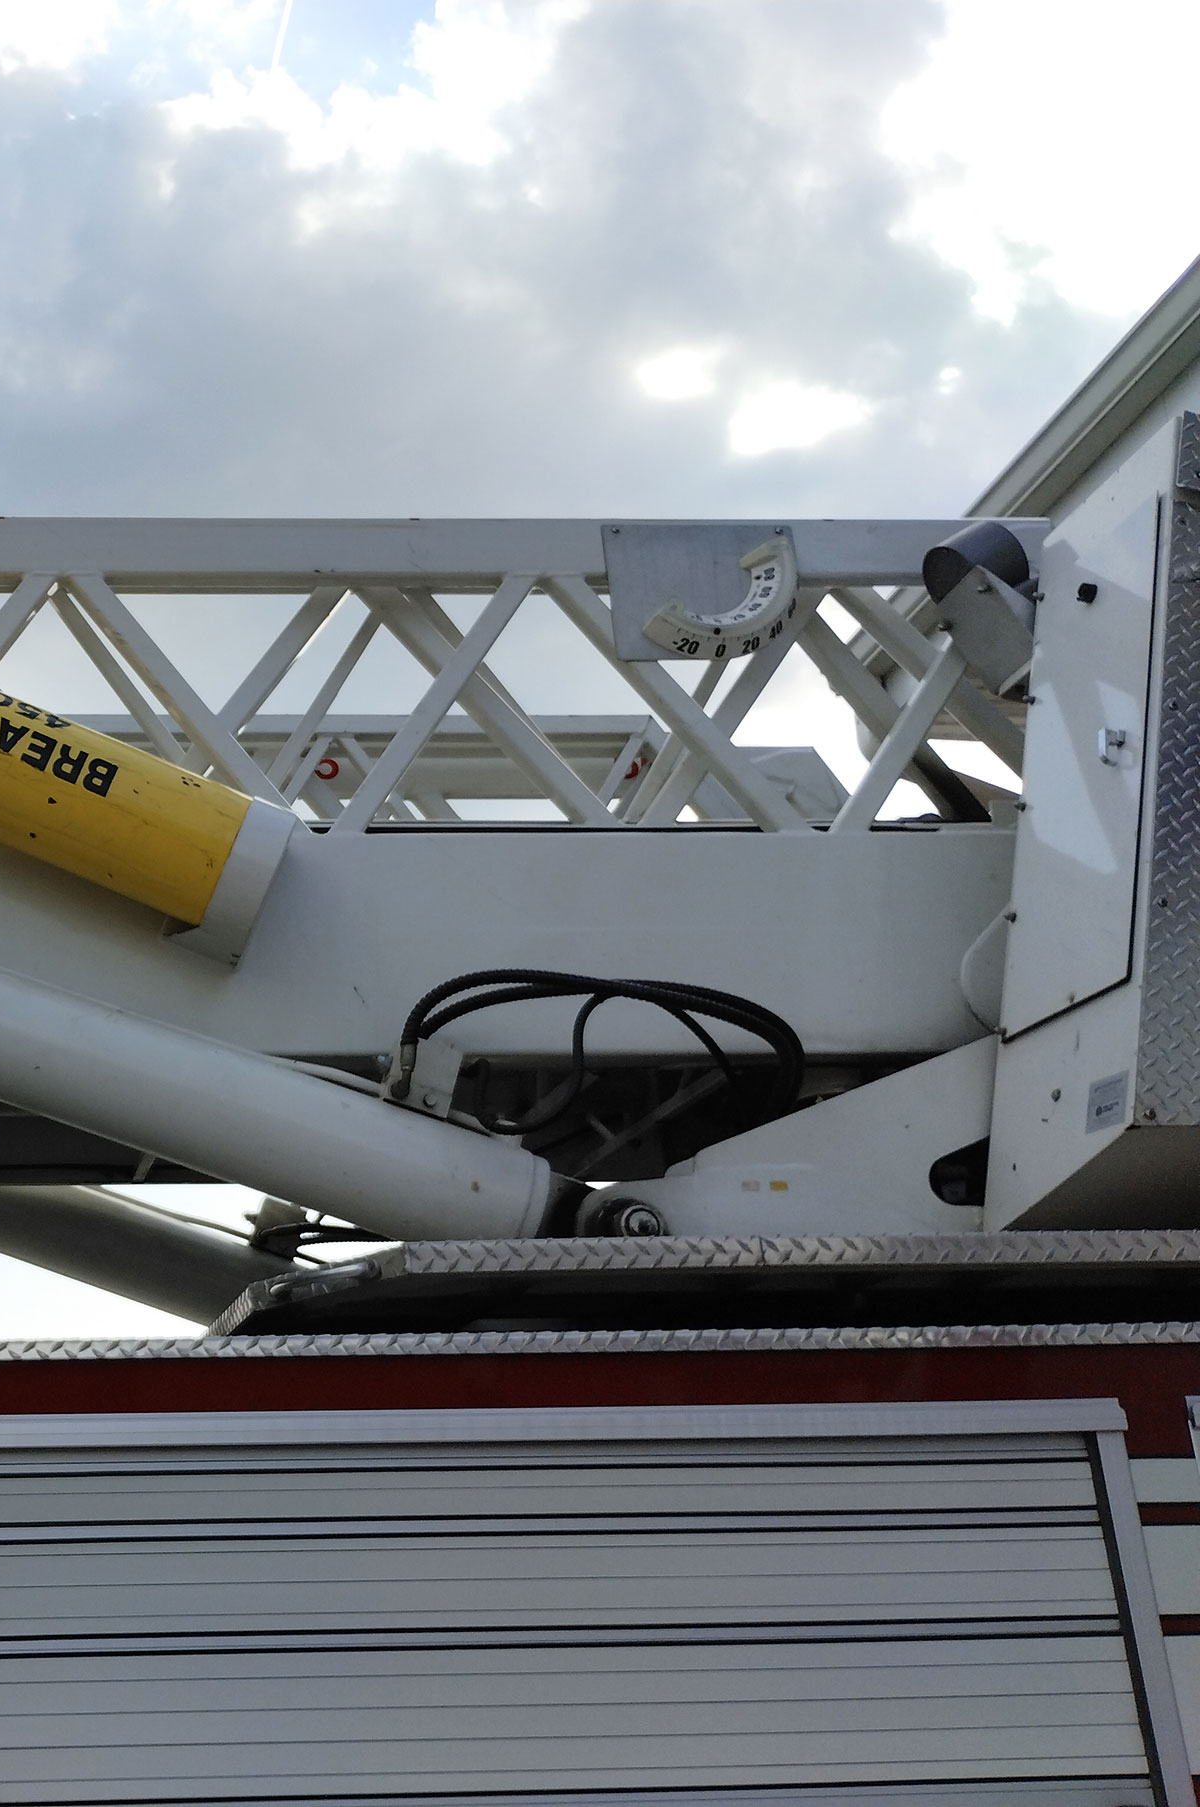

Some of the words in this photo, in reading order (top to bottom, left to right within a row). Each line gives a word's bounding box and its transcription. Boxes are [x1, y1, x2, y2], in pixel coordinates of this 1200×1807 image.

[672, 637, 700, 655] -20
[714, 643, 727, 658] 0
[742, 636, 760, 654] 20
[768, 620, 783, 640] 40
